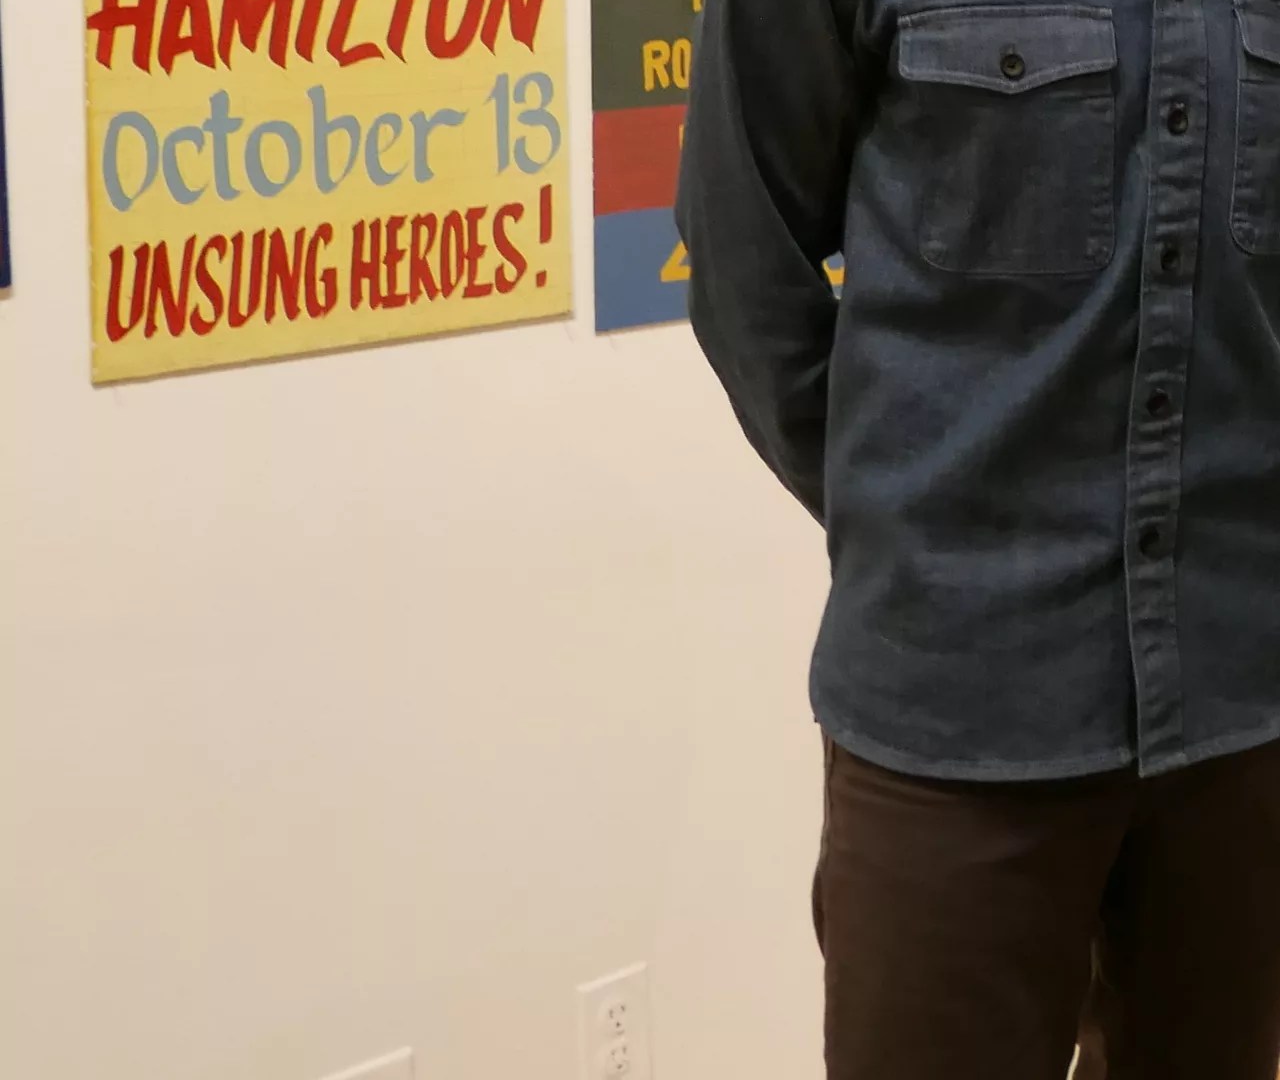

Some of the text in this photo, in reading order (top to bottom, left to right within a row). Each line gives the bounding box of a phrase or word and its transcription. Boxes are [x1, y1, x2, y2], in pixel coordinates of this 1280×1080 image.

[102, 71, 562, 213] October 13
[105, 183, 554, 343] UNSUNG HEROES!
